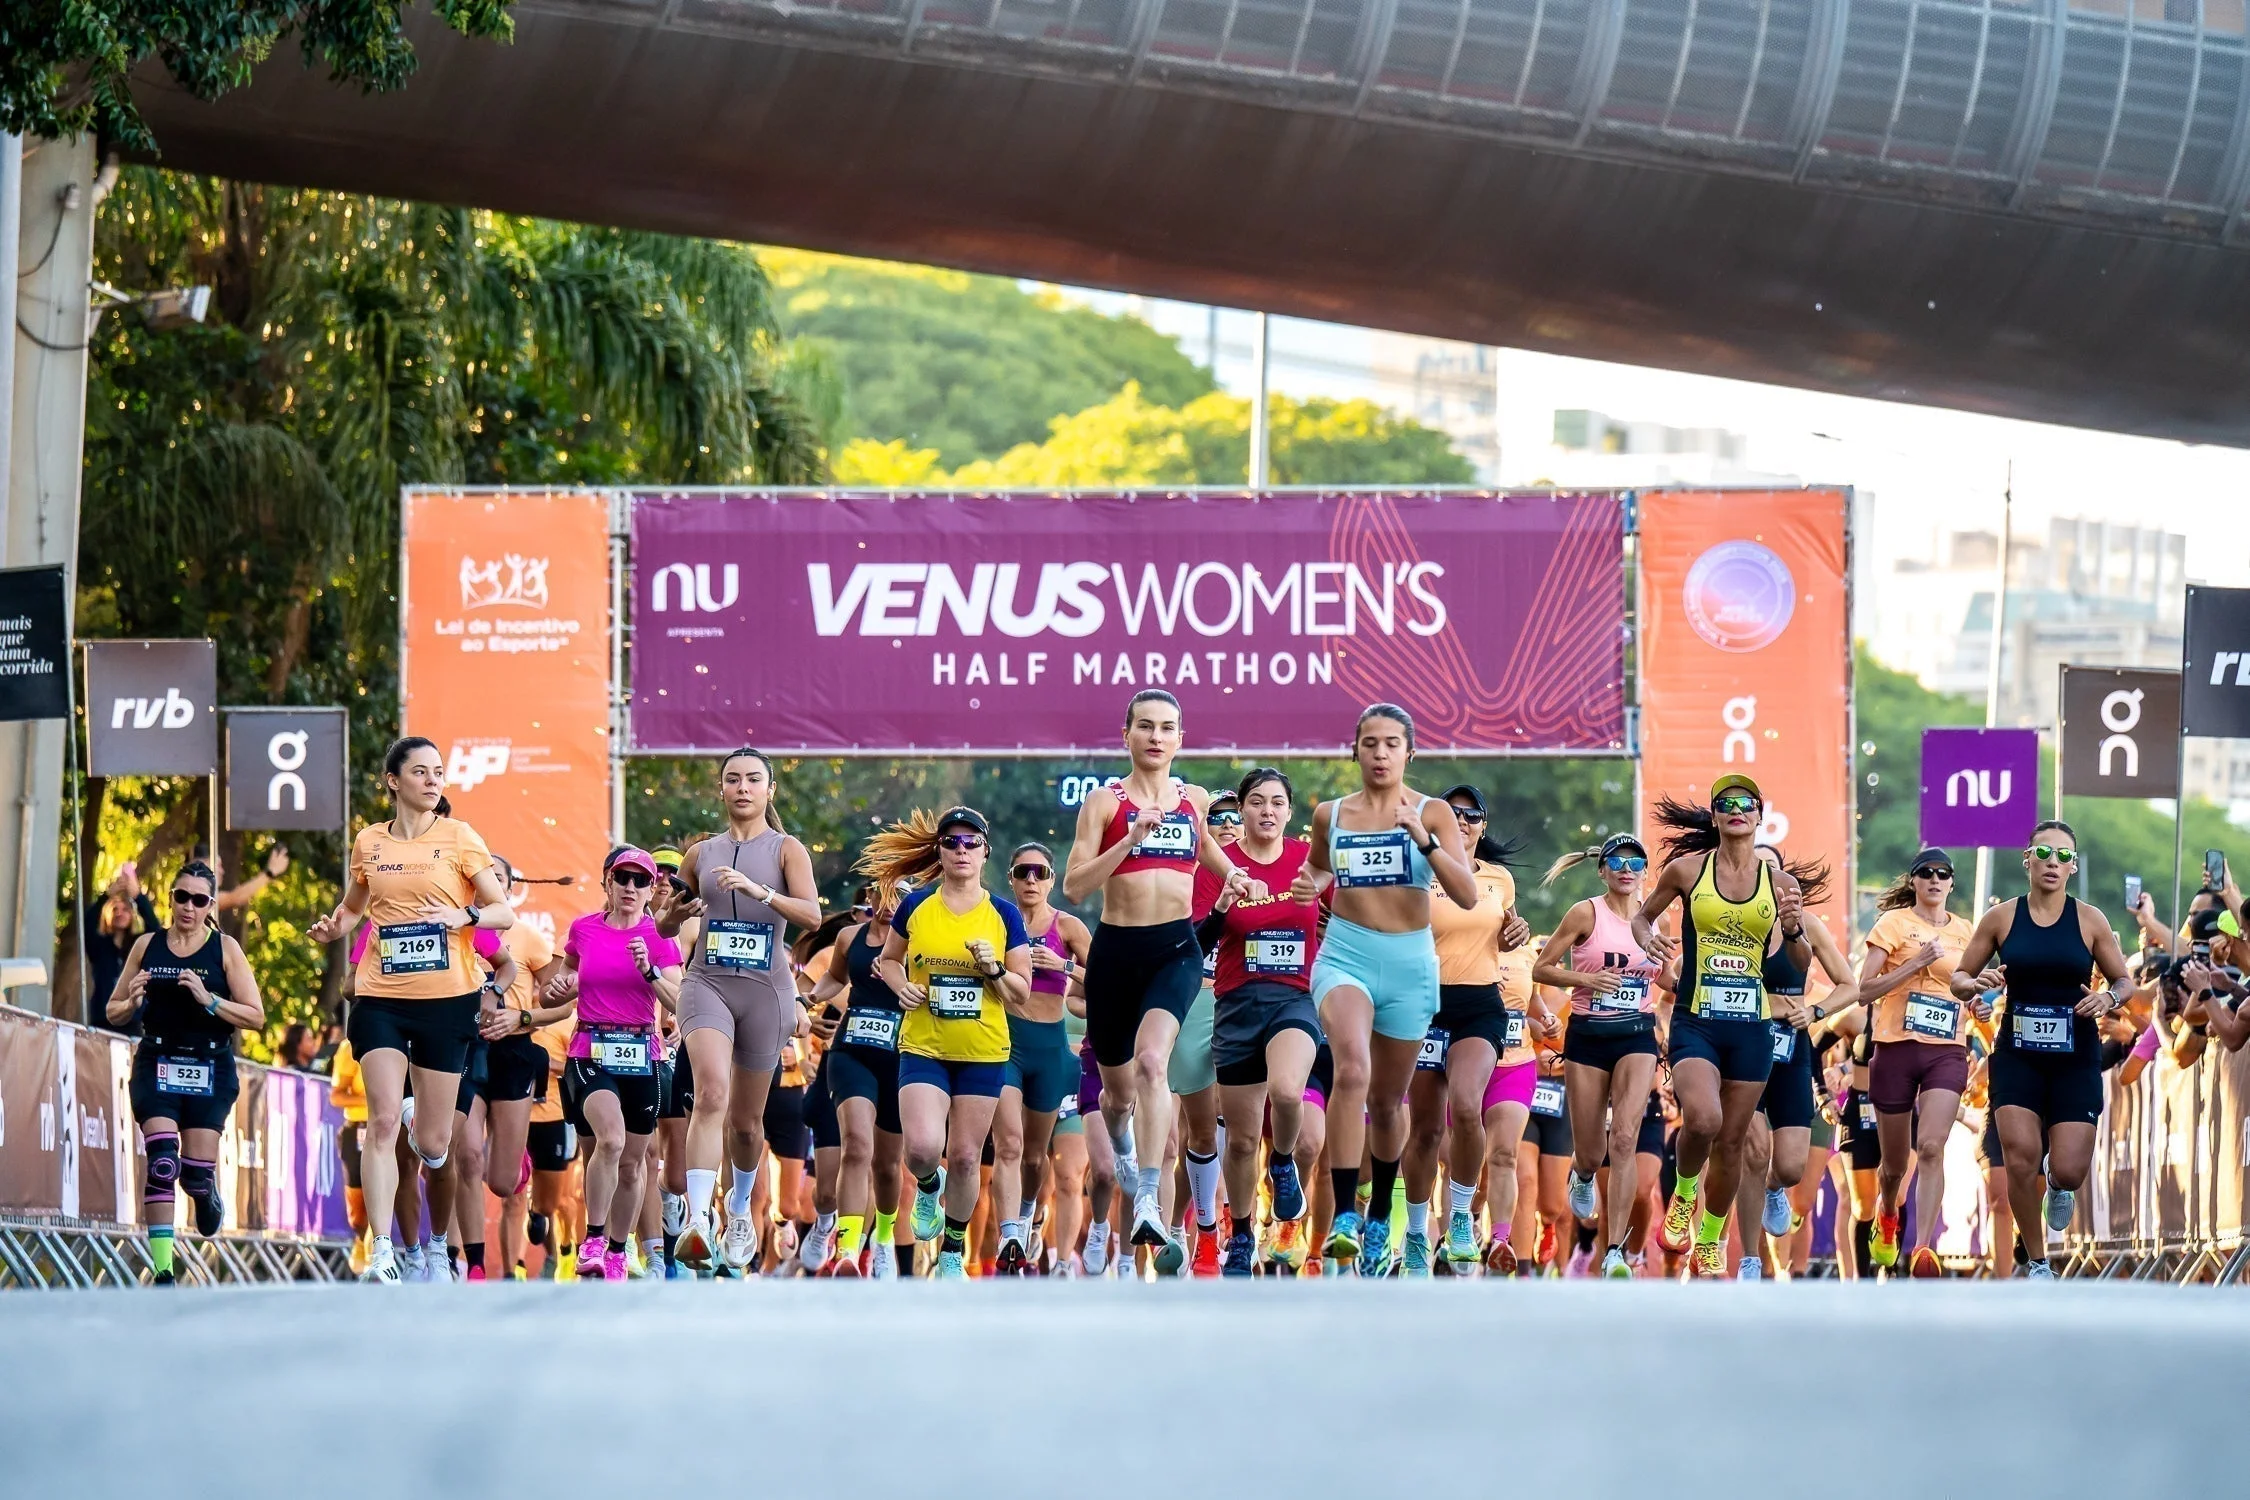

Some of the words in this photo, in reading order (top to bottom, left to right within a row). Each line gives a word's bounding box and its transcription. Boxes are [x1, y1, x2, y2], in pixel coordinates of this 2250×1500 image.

[933, 652, 1047, 686] HALF
[1073, 652, 1332, 686] MARATHON
[111, 687, 195, 729] rvb
[1153, 827, 1182, 839] 320
[1361, 851, 1393, 866] 325
[399, 939, 435, 954] 2169
[729, 936, 757, 950] 370
[1700, 936, 1755, 951] CORREDOR
[1270, 944, 1296, 957] 319
[924, 957, 971, 969] PERSONAL
[949, 990, 976, 1002] 390
[1611, 989, 1636, 1001] 303
[1723, 991, 1749, 1004] 377
[1924, 1009, 1947, 1023] 289
[859, 1020, 890, 1033] 2430
[2033, 1021, 2057, 1034] 317
[614, 1046, 637, 1058] 361
[177, 1068, 201, 1080] 523
[1535, 1091, 1553, 1102] 219
